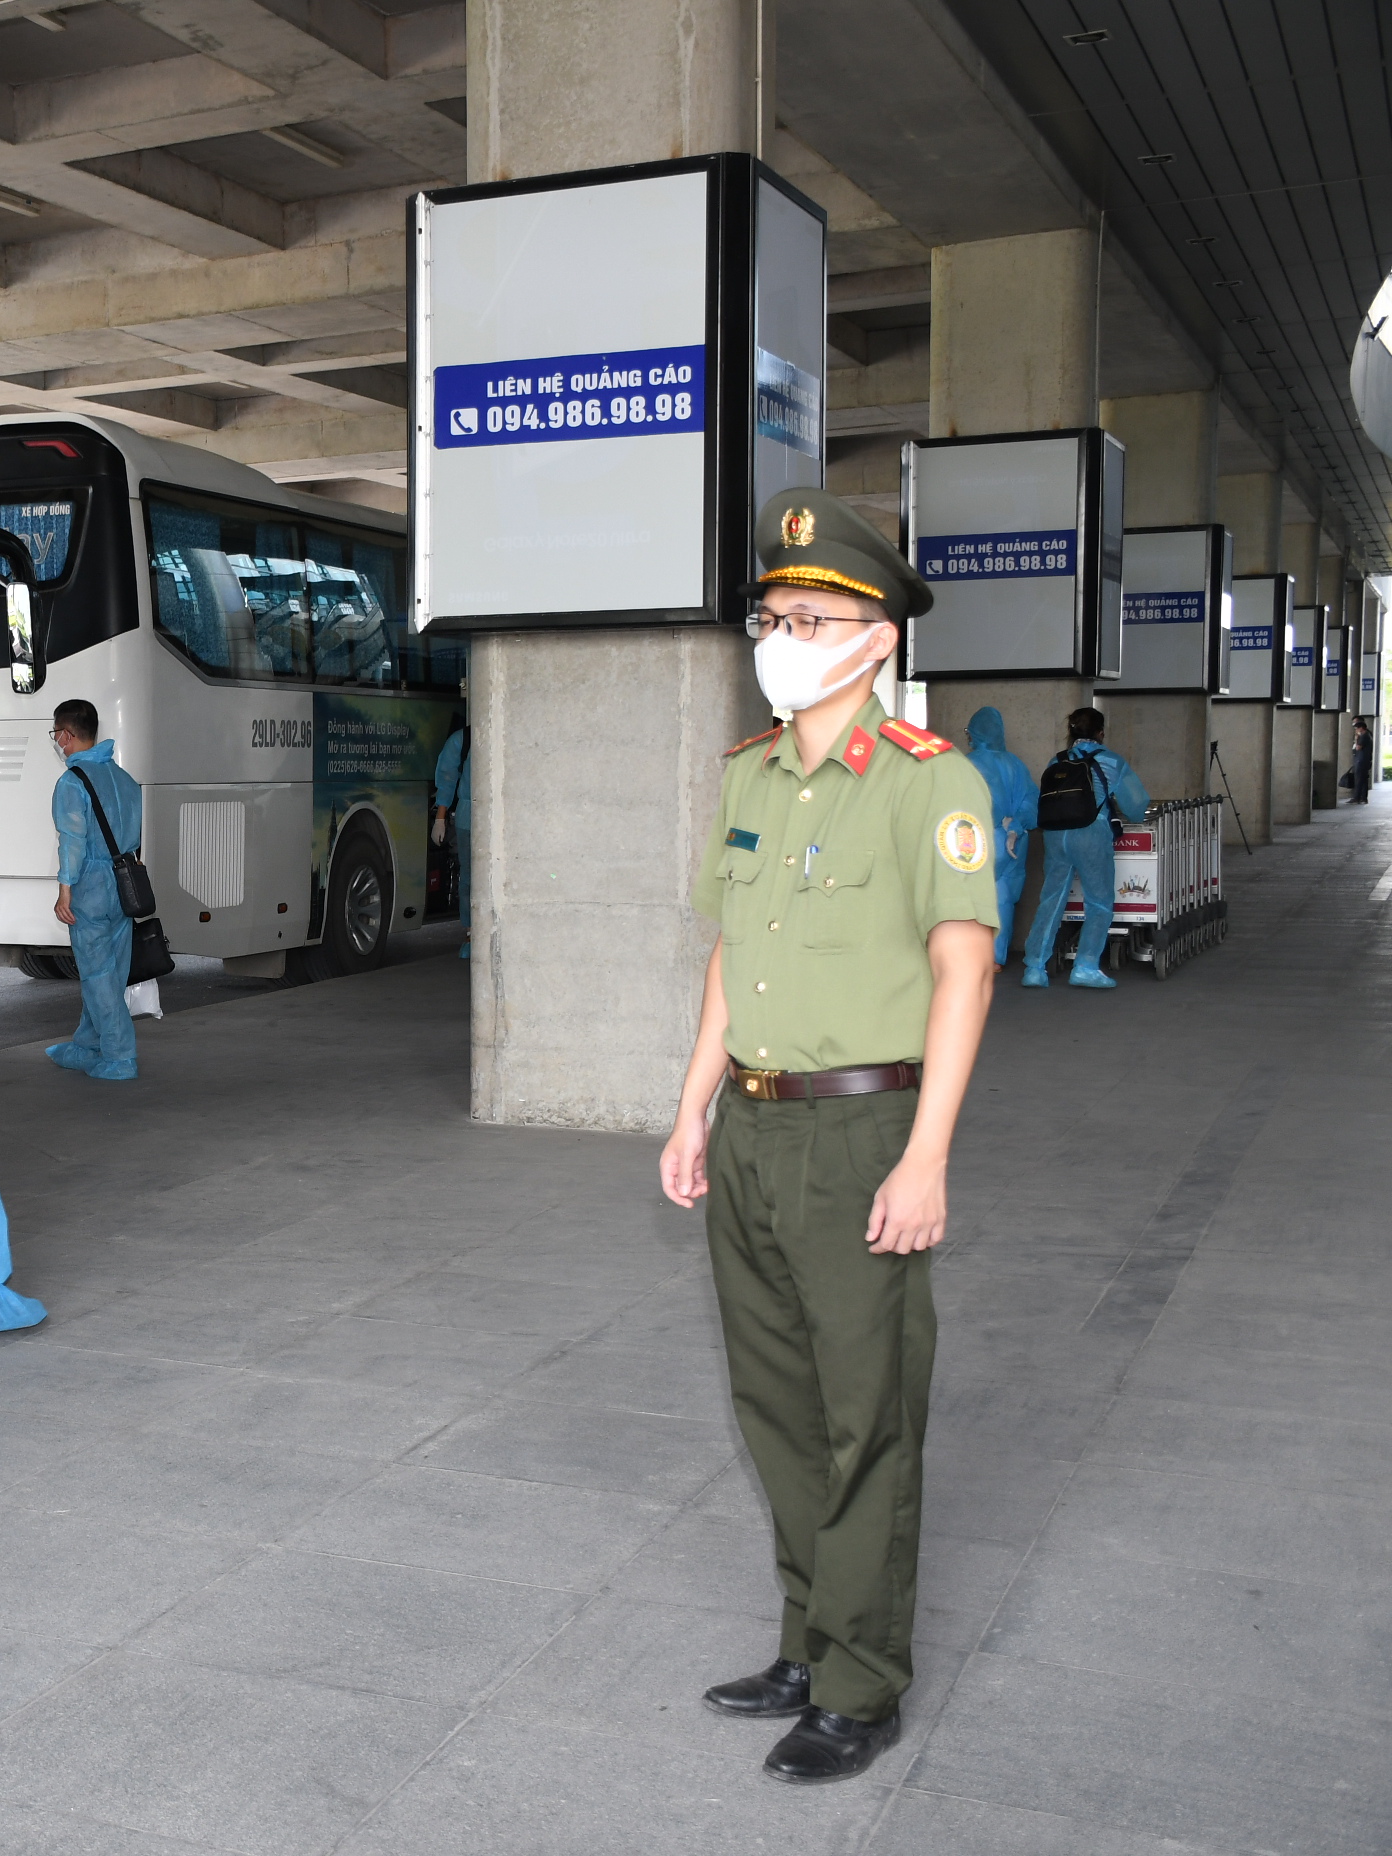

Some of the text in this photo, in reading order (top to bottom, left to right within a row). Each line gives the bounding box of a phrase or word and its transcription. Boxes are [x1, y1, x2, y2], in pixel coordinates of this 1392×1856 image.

[486, 363, 692, 398] LIÊN HỆ QUẢNG CÁO
[486, 392, 692, 433] 094.986.98.98
[21, 506, 31, 517] XE
[948, 538, 1067, 556] LIÊN HỆ QUẢNG CÁO
[947, 554, 1067, 574] 094.986.98.98
[1148, 597, 1178, 607] QUẢNG
[1180, 597, 1199, 606] CÁO
[251, 719, 312, 749] 29LD-302.96
[376, 721, 386, 735] LG
[387, 722, 410, 739] Display
[340, 743, 347, 754] ra
[369, 741, 378, 754] lai
